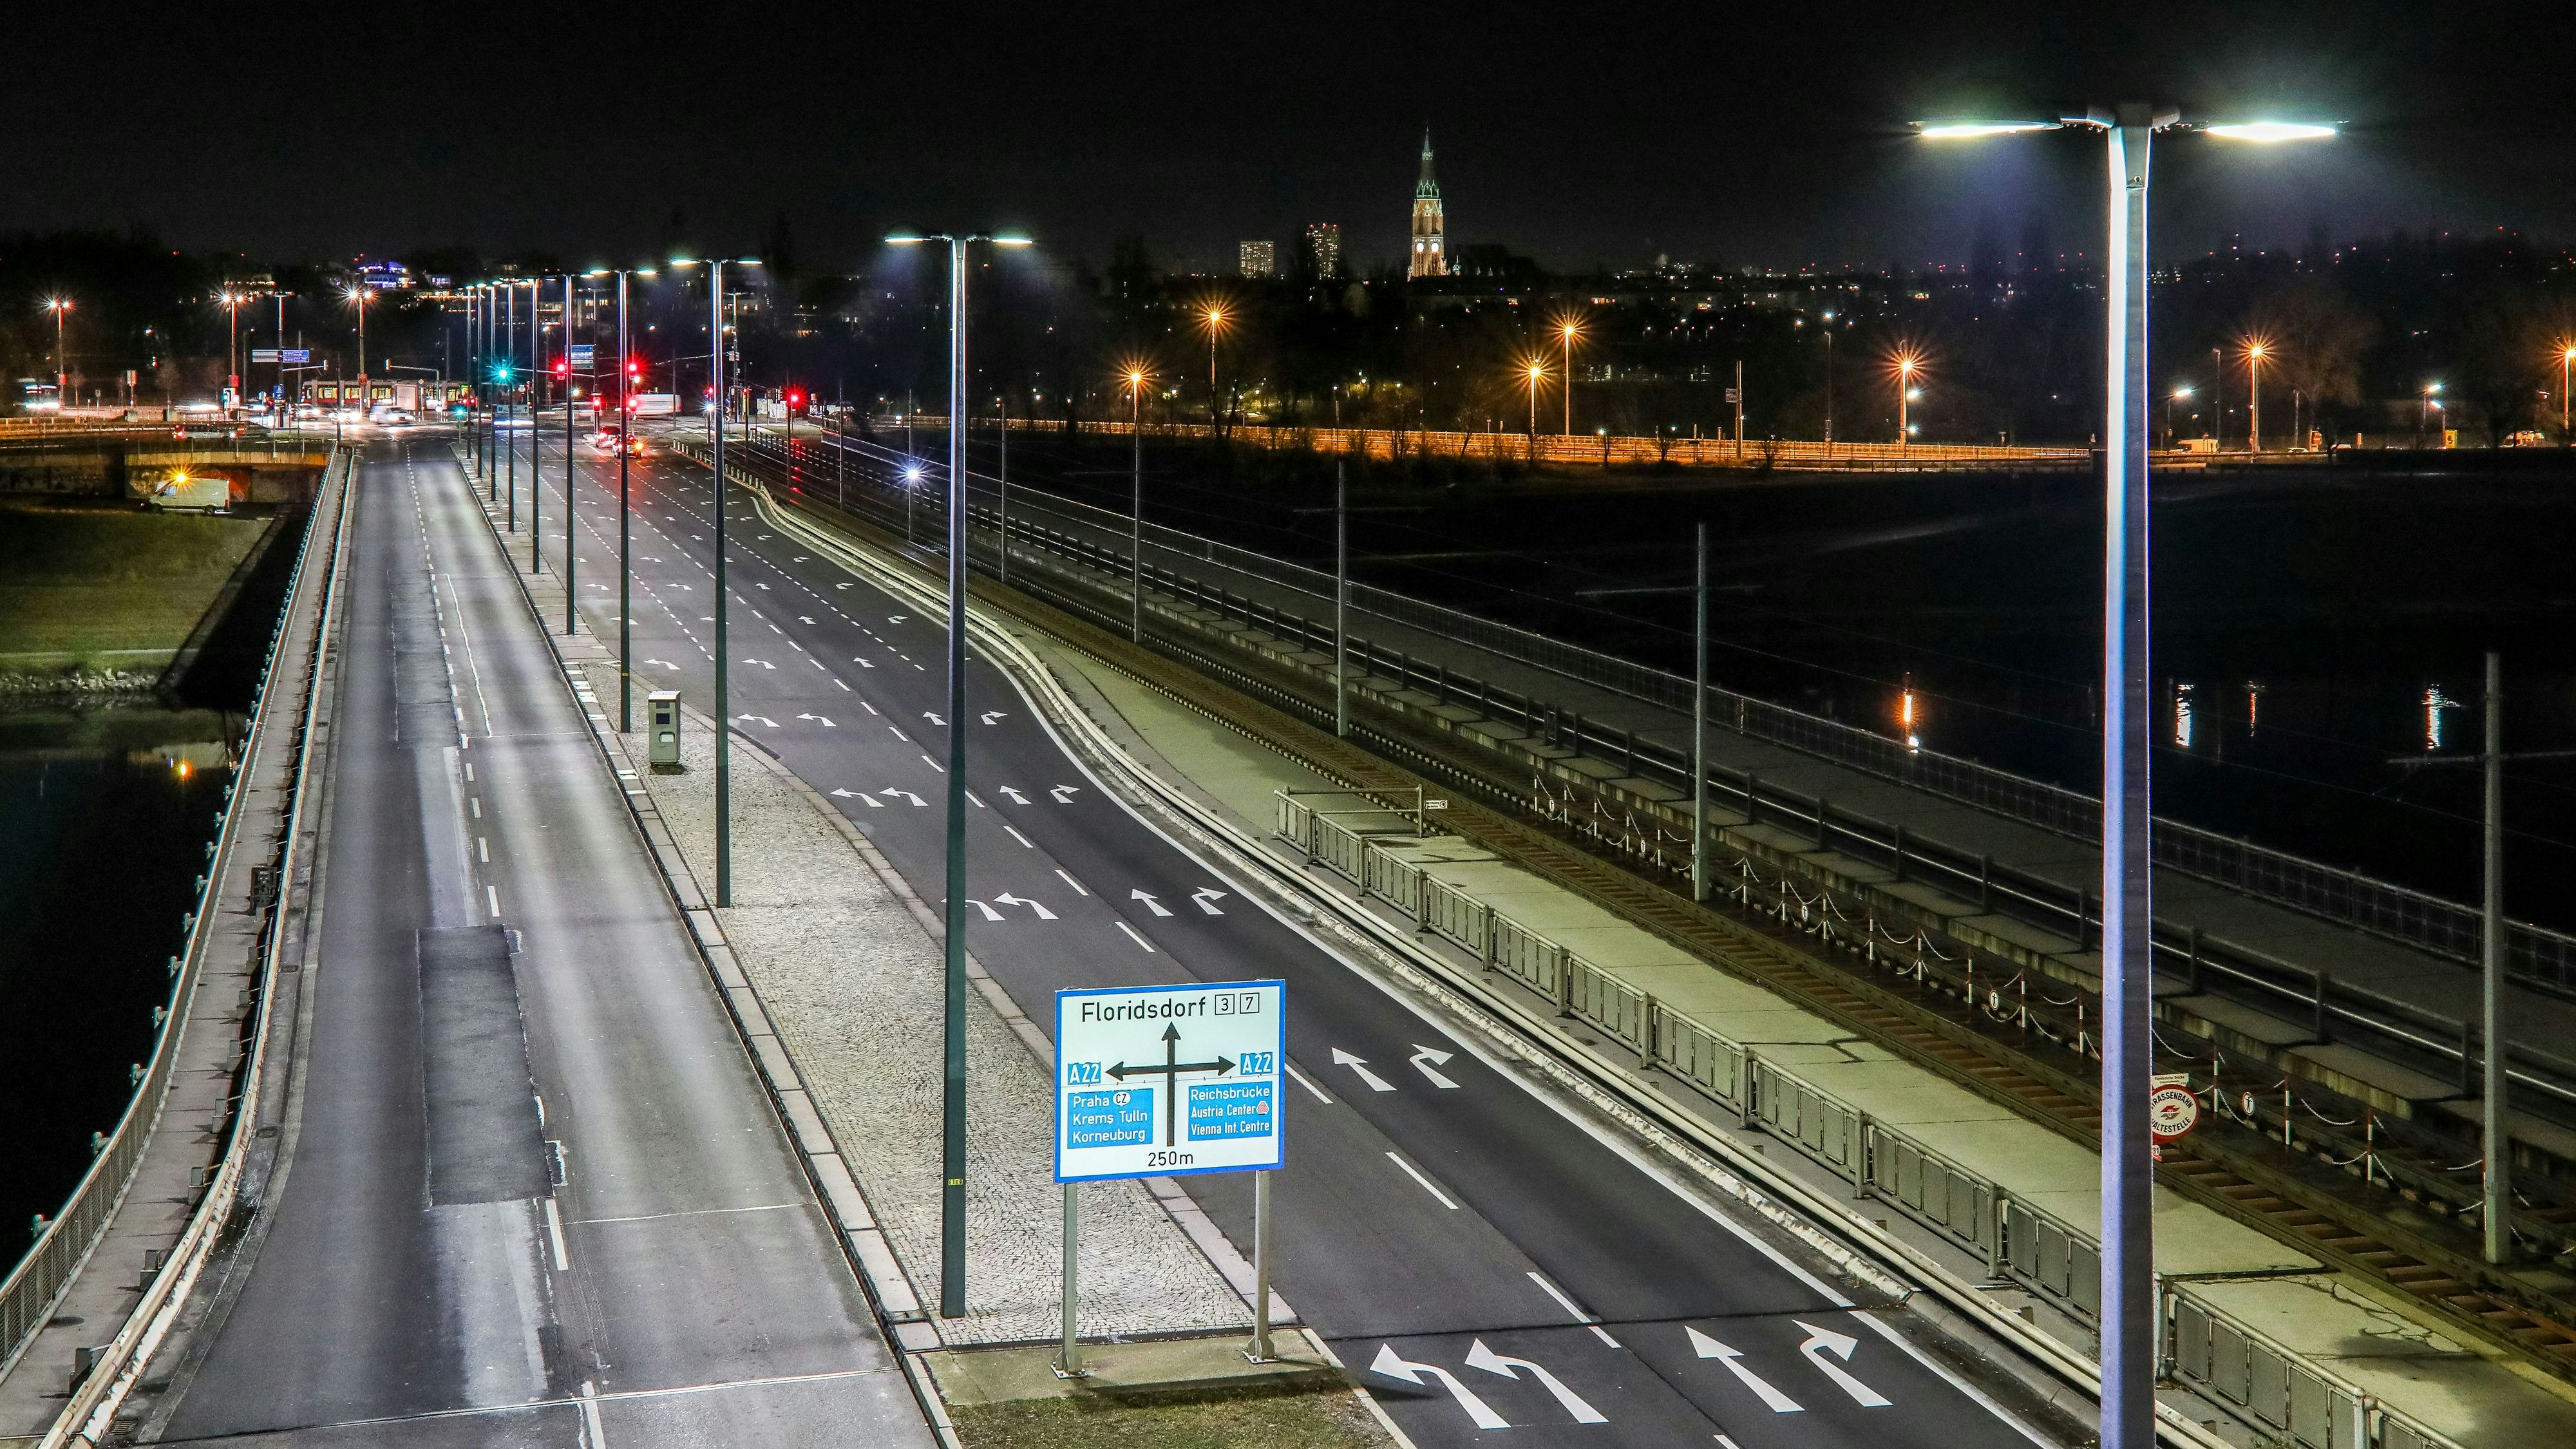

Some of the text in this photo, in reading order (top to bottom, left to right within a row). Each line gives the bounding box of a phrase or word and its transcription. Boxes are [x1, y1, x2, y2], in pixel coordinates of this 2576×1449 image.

[1081, 996, 1253, 1022] Floridsdorf 3 7
[1073, 1094, 1127, 1108] Praha CZ
[1191, 1086, 1270, 1101] Reichsbrücke
[1072, 1110, 1148, 1125] Krems Tulln
[1191, 1104, 1256, 1118] Austria Center
[1191, 1119, 1269, 1135] Vienna Int. Centre
[1072, 1129, 1146, 1144] Korneuburg
[1148, 1151, 1193, 1167] 250m
